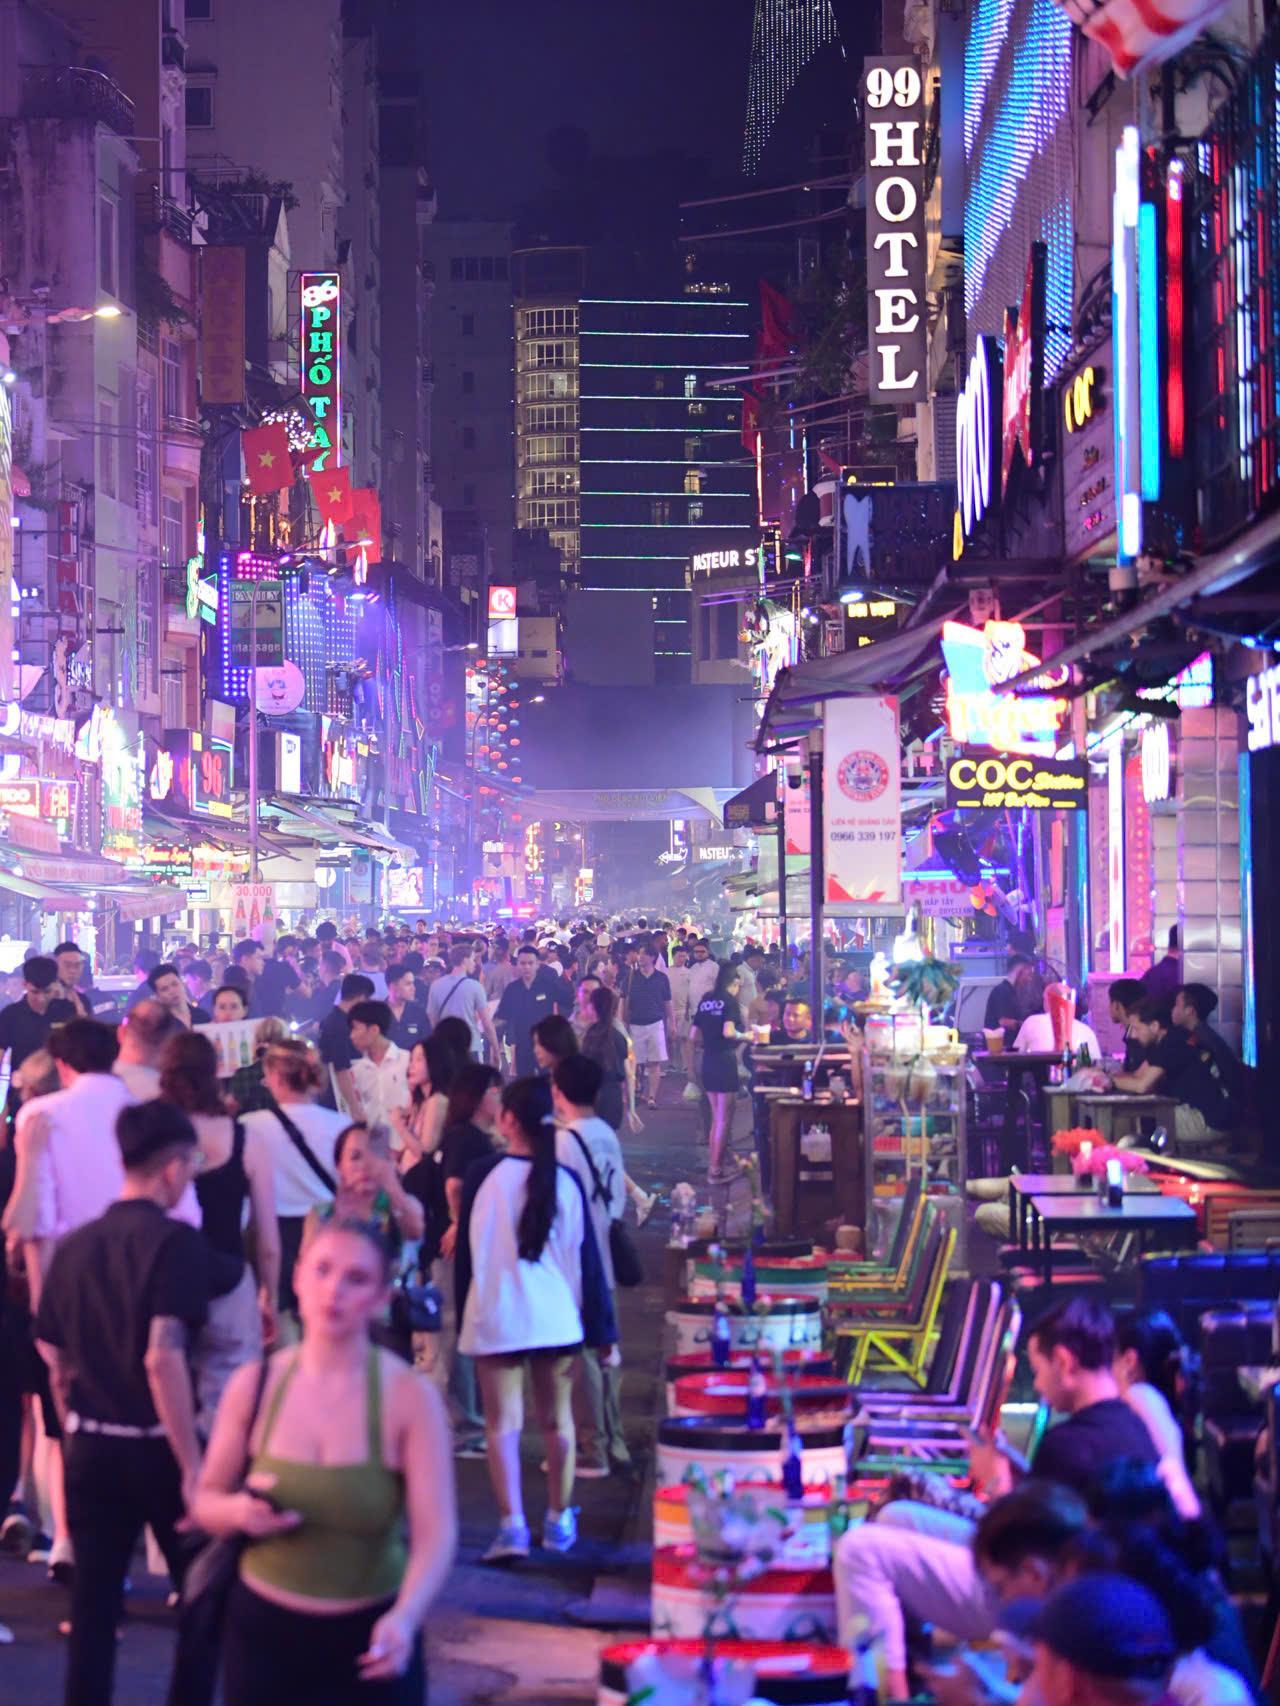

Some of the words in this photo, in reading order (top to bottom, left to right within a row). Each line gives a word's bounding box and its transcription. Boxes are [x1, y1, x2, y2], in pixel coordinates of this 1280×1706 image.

[866, 67, 921, 108] 99
[869, 120, 921, 390] HOTEL
[693, 550, 740, 571] PASTEUR
[745, 548, 760, 566] S
[949, 758, 1033, 791] COC
[830, 831, 855, 841] 0966
[857, 831, 876, 841] 339
[879, 831, 896, 841] 197
[235, 886, 273, 897] 30.000
